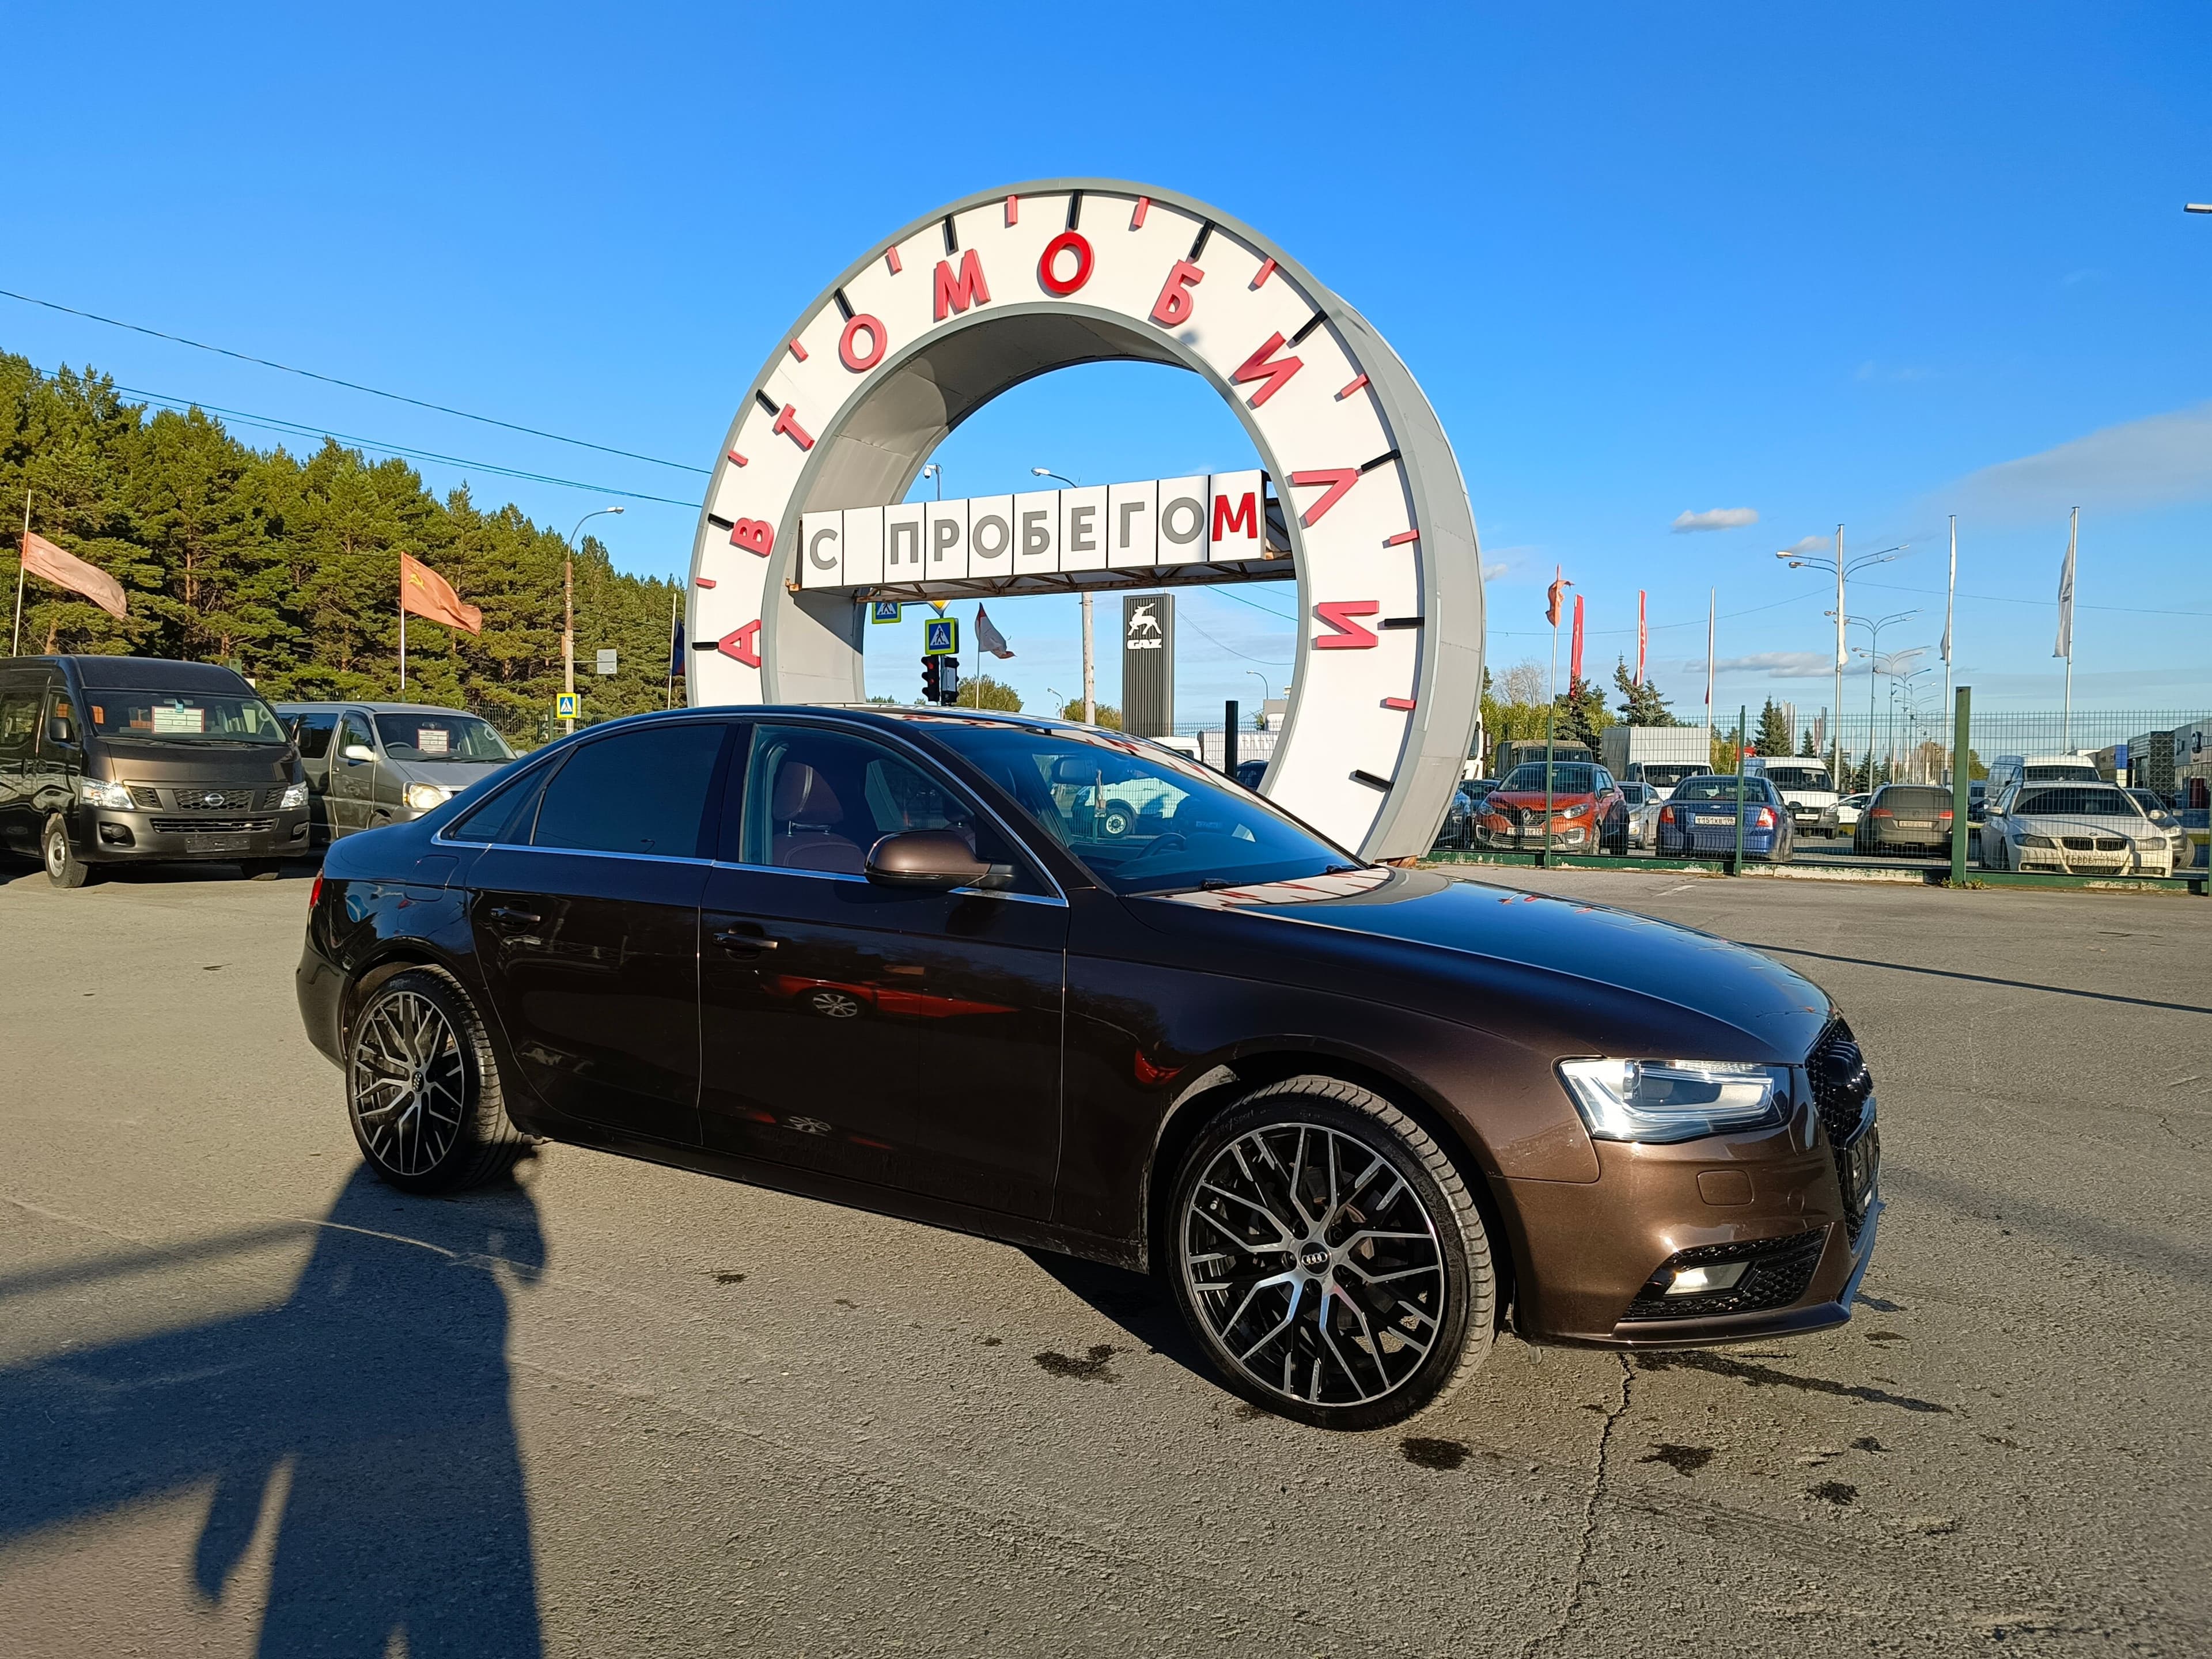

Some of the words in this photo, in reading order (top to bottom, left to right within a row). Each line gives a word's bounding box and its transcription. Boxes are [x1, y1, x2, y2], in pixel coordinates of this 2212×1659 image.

[718, 232, 1380, 668] АВТОМОБИЛИ
[810, 528, 838, 570] С
[891, 491, 1258, 565] ПРОБЕГОМ
[1127, 638, 1162, 650] GAZ
